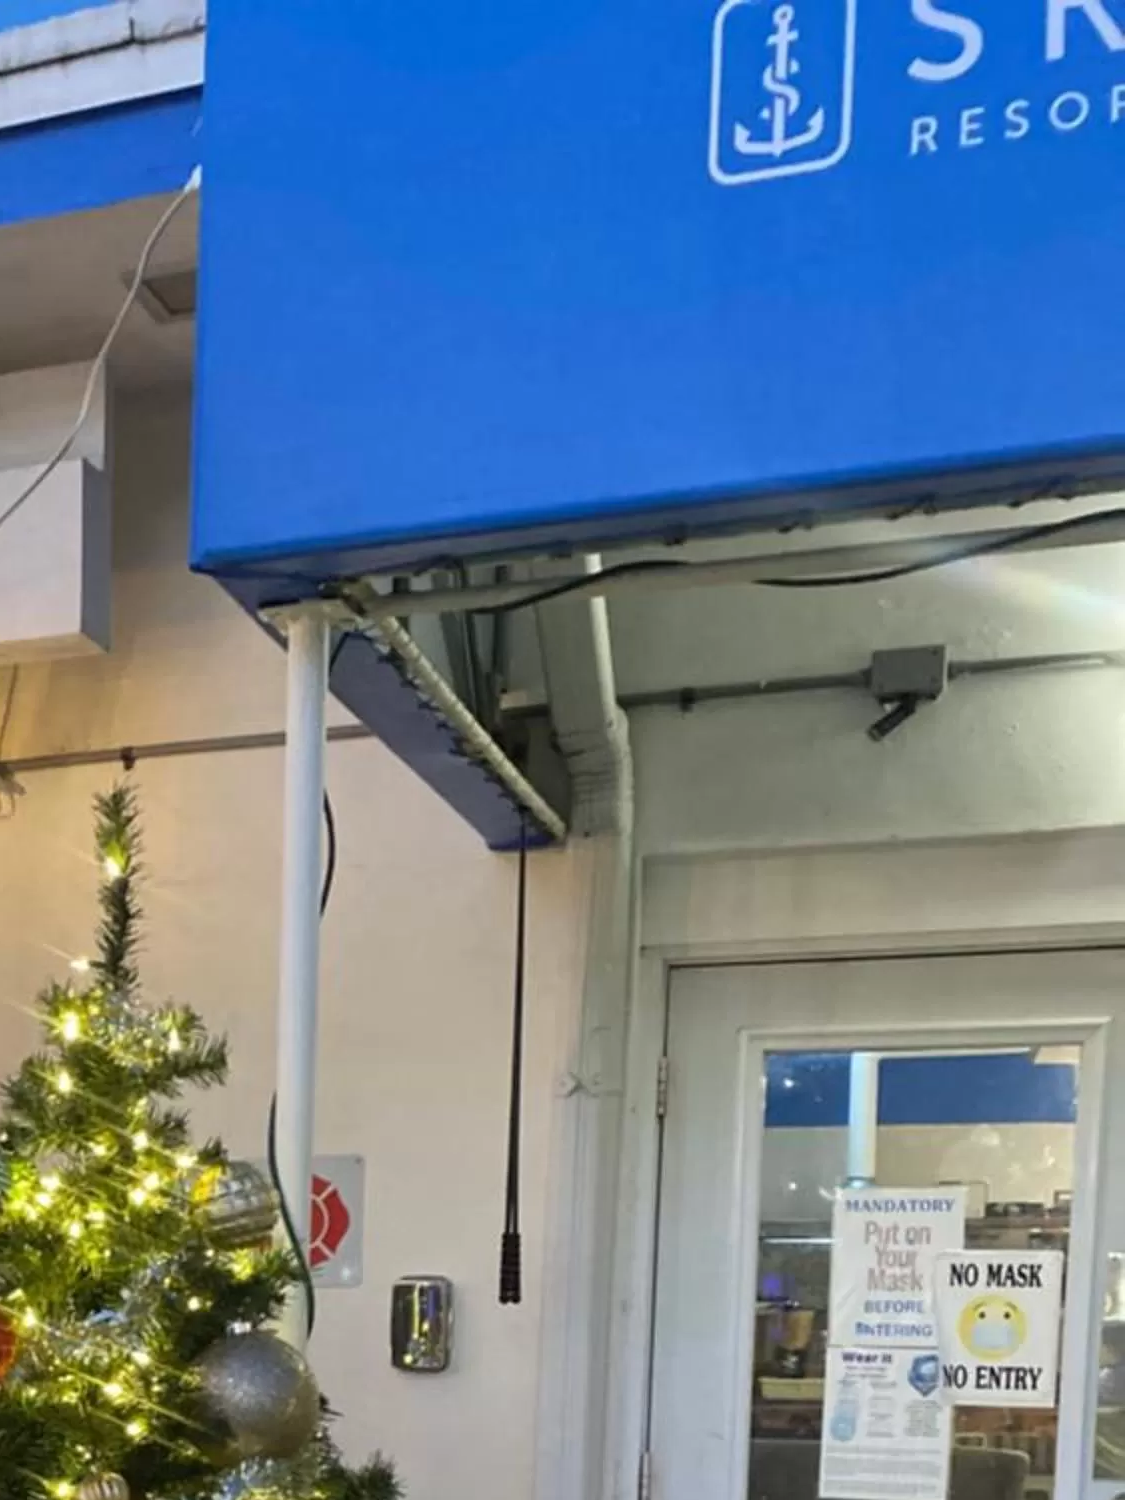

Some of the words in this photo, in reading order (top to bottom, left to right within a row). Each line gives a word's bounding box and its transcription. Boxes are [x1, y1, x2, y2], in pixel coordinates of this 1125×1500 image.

[845, 1199, 955, 1213] MANDATORY
[864, 1220, 899, 1245] Put
[905, 1226, 932, 1245] on
[875, 1245, 918, 1269] Your
[867, 1268, 924, 1292] Mask
[949, 1263, 979, 1288] NO
[986, 1263, 1043, 1288] MASK
[864, 1300, 924, 1314] BEFORE
[855, 1321, 933, 1337] ENTERING
[942, 1364, 968, 1389] NO
[975, 1365, 1043, 1390] ENTRY
